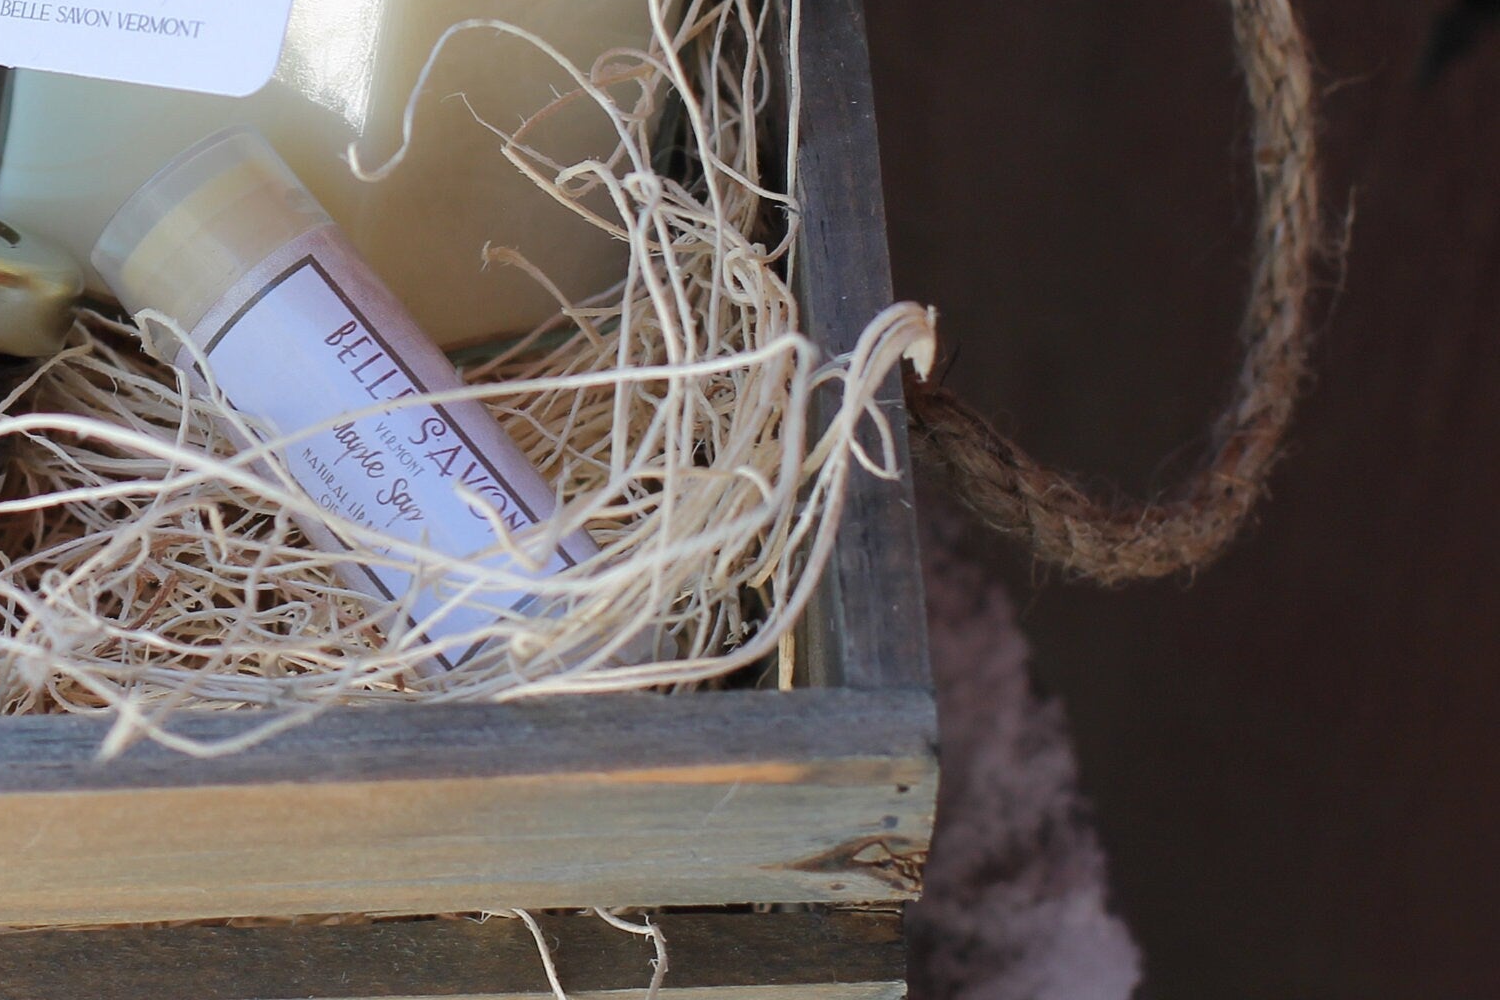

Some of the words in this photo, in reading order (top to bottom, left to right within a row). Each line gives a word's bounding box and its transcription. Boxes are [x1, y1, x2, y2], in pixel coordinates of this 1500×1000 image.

[0, 0, 51, 23] BELLE
[56, 4, 112, 29] SAVON
[117, 12, 205, 39] VERMONT
[302, 447, 349, 503] NATURAL
[375, 422, 426, 477] VERMONT
